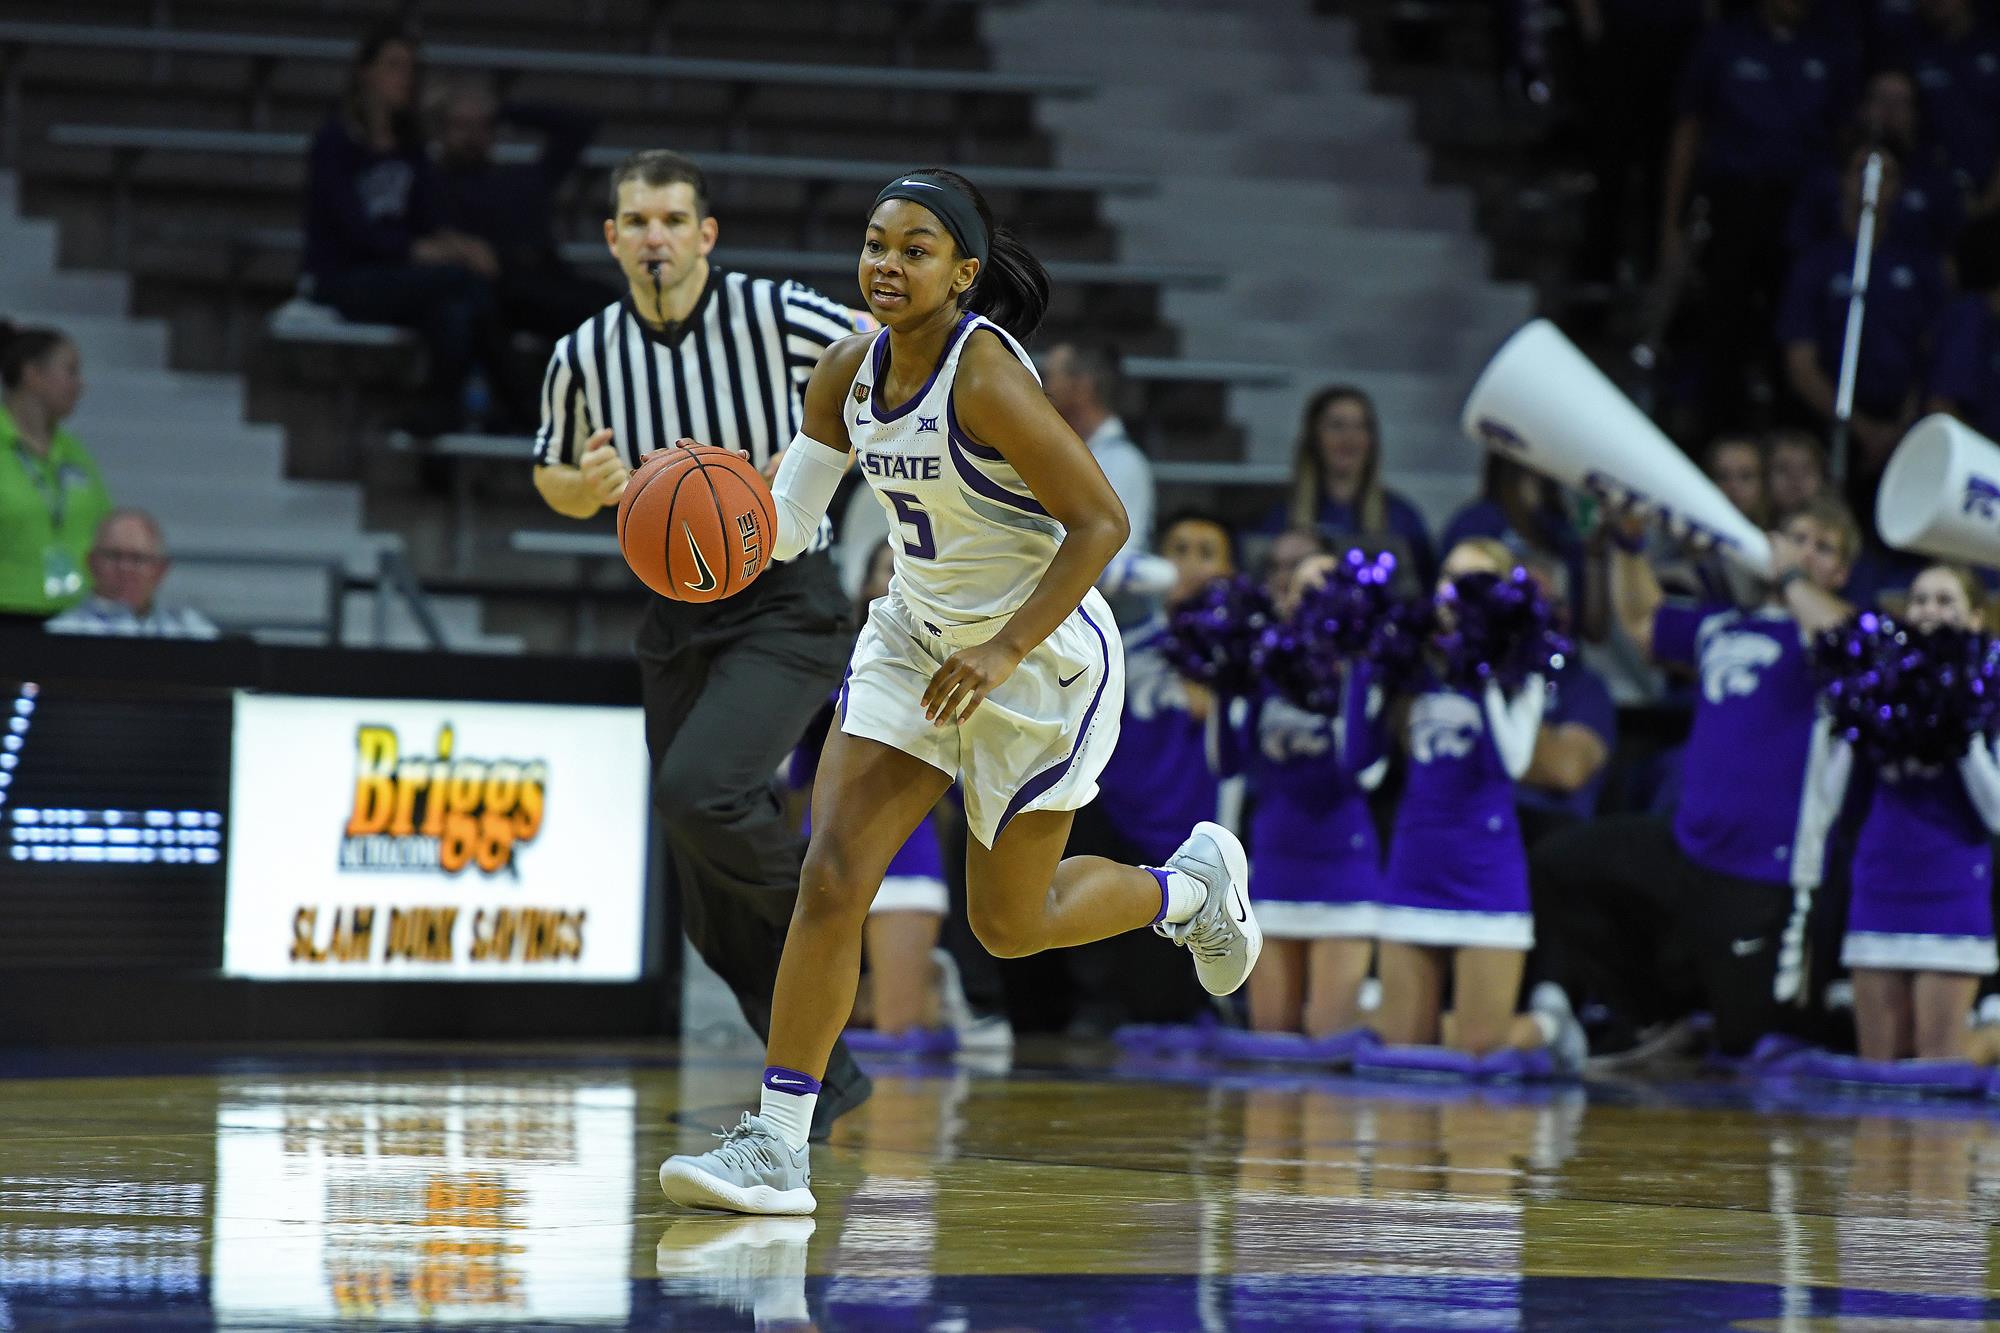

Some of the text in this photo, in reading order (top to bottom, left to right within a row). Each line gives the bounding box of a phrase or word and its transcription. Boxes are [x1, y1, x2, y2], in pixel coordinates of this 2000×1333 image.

[856, 448, 942, 481] -STATE
[736, 510, 758, 581] ELITE
[881, 488, 938, 561] 5
[345, 721, 547, 875] Briggs
[290, 904, 376, 962] SLAM
